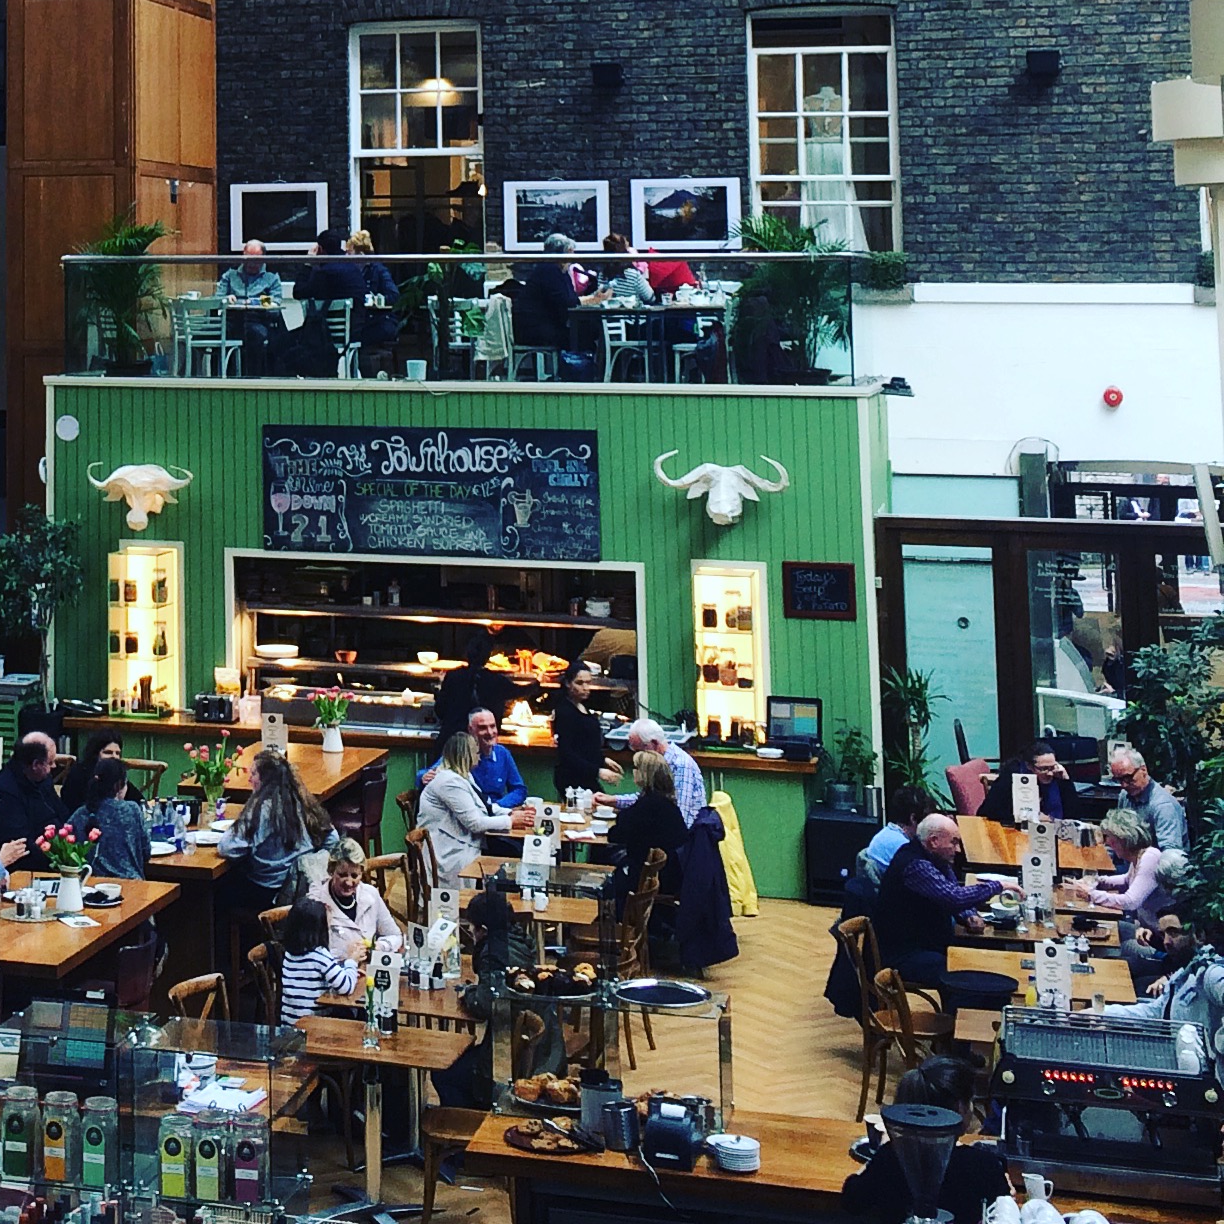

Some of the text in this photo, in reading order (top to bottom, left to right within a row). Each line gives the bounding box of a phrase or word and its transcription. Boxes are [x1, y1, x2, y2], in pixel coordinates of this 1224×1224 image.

[370, 431, 509, 475] Townhouse
[354, 482, 399, 497] SPECIAL
[404, 483, 419, 498] OF
[421, 483, 444, 499] THE
[449, 484, 473, 500] DAY
[290, 494, 336, 514] DOWN
[377, 498, 445, 514] SPAGHETTI
[412, 514, 474, 529] SUNDRIED
[367, 523, 487, 540] TOMATO SAUCE AND
[367, 535, 494, 555] CHICKEN SUPREME
